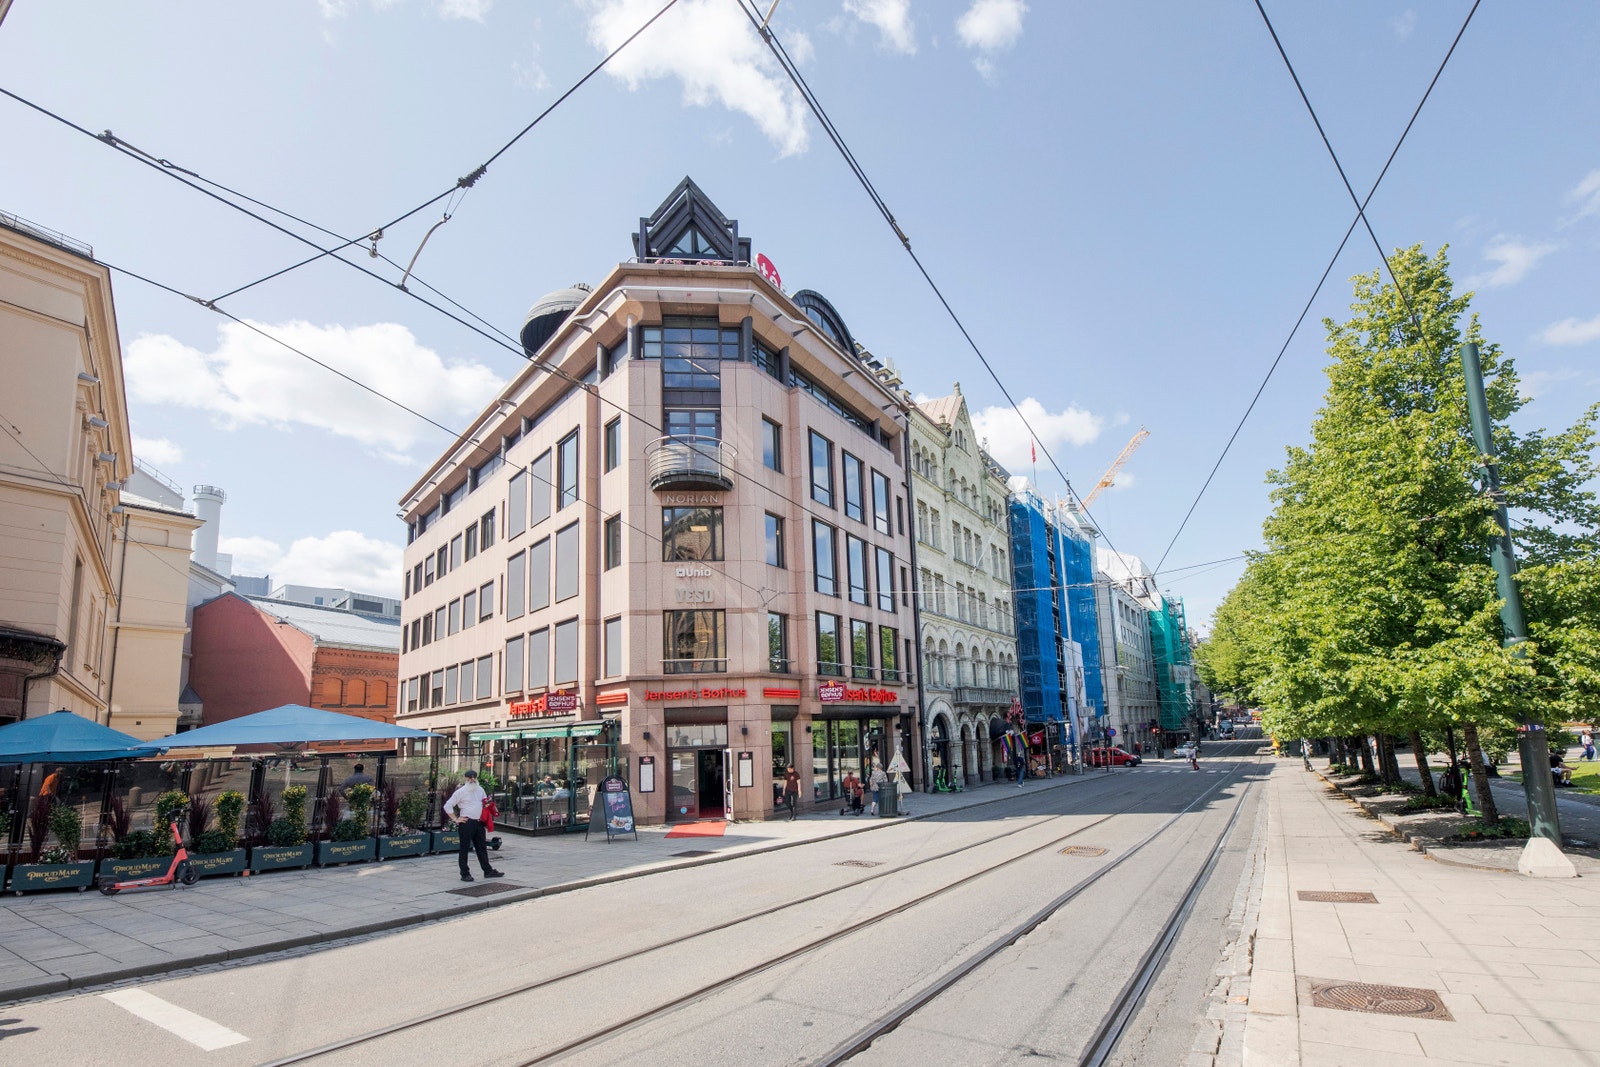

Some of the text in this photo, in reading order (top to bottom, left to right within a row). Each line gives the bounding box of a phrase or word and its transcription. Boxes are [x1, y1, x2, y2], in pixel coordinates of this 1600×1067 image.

[666, 494, 718, 503] NORIAN
[685, 566, 712, 577] Unio
[644, 687, 747, 701] Jensen's Bøfhus
[27, 871, 58, 881] PROUD
[58, 869, 80, 878] MARY
[112, 865, 141, 875] PROUD
[141, 863, 161, 872] MARY
